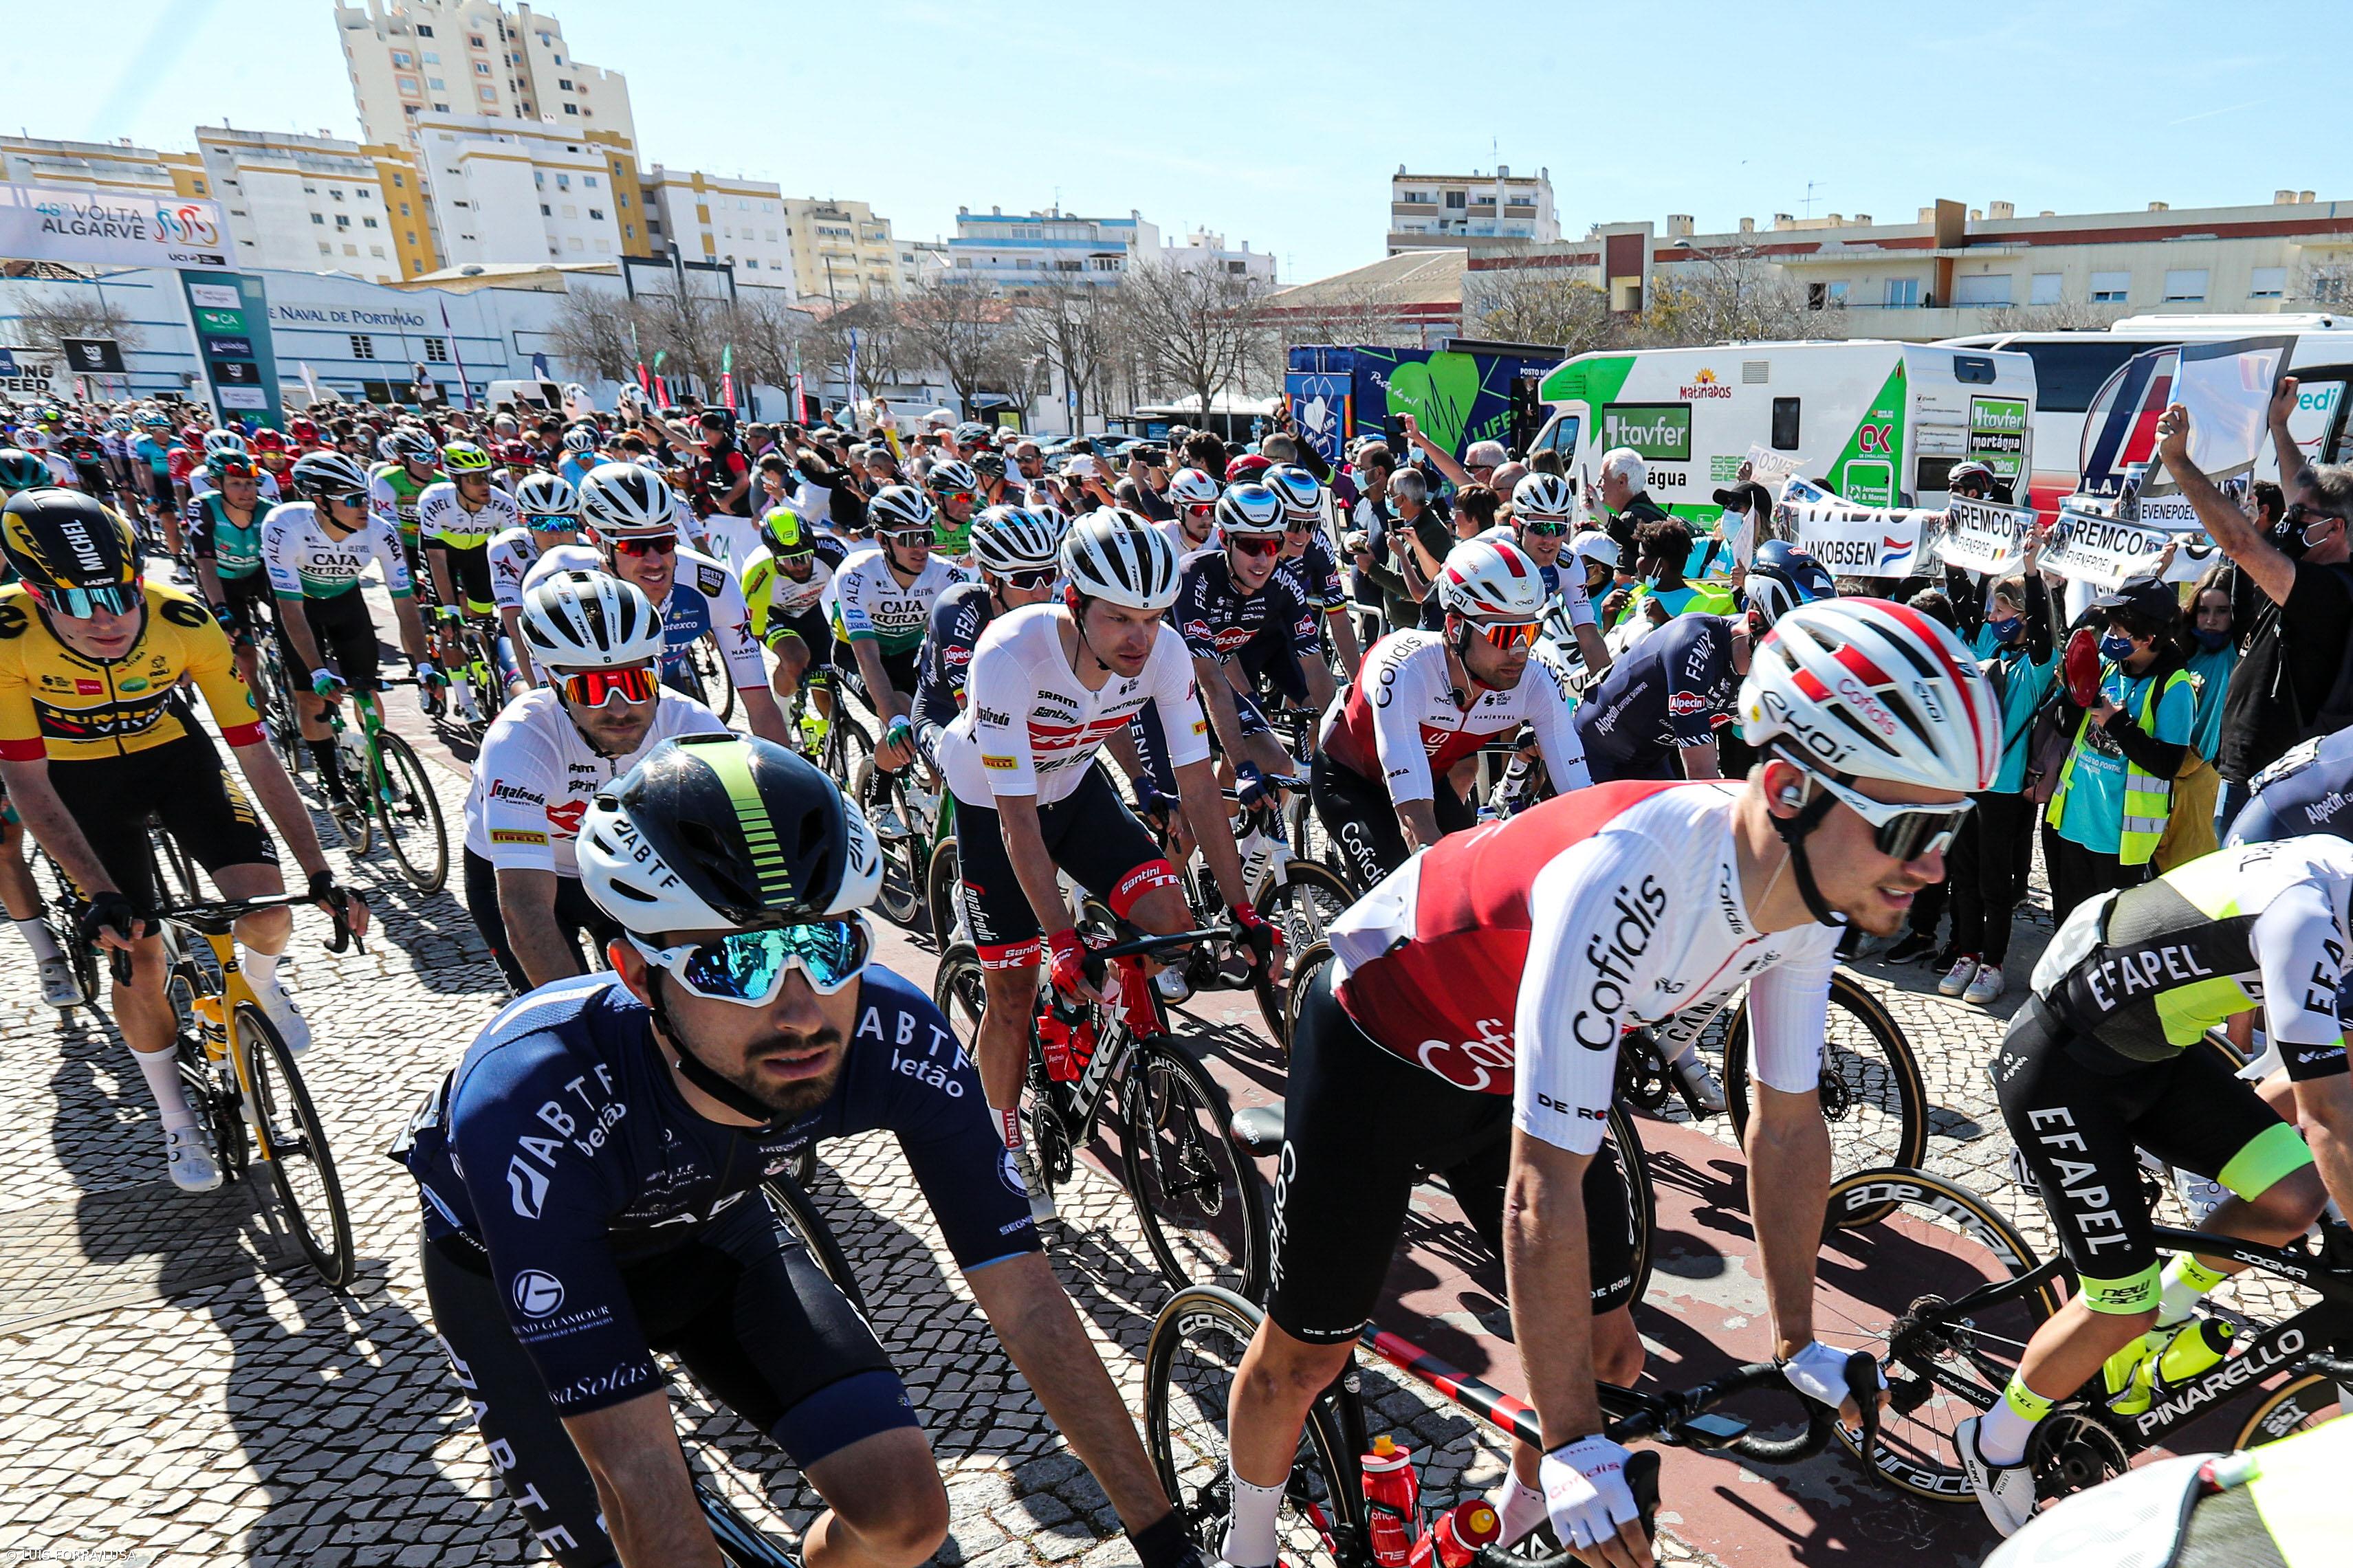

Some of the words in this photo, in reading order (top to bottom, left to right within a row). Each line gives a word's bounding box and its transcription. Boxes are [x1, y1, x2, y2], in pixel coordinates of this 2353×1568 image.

[72, 203, 144, 224] VOLTA
[41, 218, 146, 241] ALGARVE
[219, 313, 239, 325] CA
[278, 305, 327, 322] NAVAL
[329, 310, 349, 323] DE
[351, 310, 425, 327] PORTIMÃO
[1520, 367, 1540, 375] POSTO
[1982, 407, 2022, 429] tavfer
[1972, 434, 2021, 452] mortágua
[1647, 466, 1687, 490] água
[2083, 477, 2118, 495] L.A.
[422, 498, 451, 529] EFAPEL
[1960, 504, 2013, 538] REMCO
[2141, 504, 2195, 521] EVENEPOEL
[60, 519, 107, 571] MICHEL
[267, 526, 287, 566] ALEA
[382, 533, 403, 562] RGA
[1956, 536, 1992, 558] EVENEPOEL
[2072, 520, 2143, 555] REMCO
[1805, 541, 1877, 566] JAKOBSEN
[2065, 550, 2111, 573] EVENEPOEL
[846, 571, 864, 605] ALEA
[1130, 564, 1141, 593] TREK
[1194, 573, 1210, 610] FENIX
[1271, 567, 1306, 606] Alpecin
[880, 600, 926, 615] CAJA
[953, 599, 982, 641] FENIX
[573, 613, 593, 645] TREK
[1214, 632, 1251, 647] lpecin
[1685, 630, 1716, 681] FENIX
[1376, 636, 1422, 709] Cofidis
[1037, 689, 1080, 709] SRAM
[1670, 697, 1703, 709] Alpecin
[1837, 678, 1900, 736] Cofidis
[1032, 706, 1079, 725] Santini
[1595, 705, 1619, 736] Alpecin
[2303, 791, 2347, 825] Alpecin
[622, 832, 680, 890] ABTF
[1341, 821, 1388, 889] Cofidi
[1121, 866, 1161, 896] Santini
[1718, 862, 1747, 936] Cofidis
[981, 958, 1022, 970] EK
[1572, 874, 1668, 1052] Cofidis
[2086, 943, 2212, 1012] EFAPEL
[855, 1005, 970, 1070] ABTF
[1044, 1043, 1066, 1051] TREK
[1070, 994, 1130, 1118] TREK
[518, 1061, 613, 1169] ABTF
[1537, 1092, 1570, 1115] DE
[1577, 1107, 1608, 1121] RO
[1005, 1110, 1021, 1145] TREK
[2026, 1105, 2127, 1256] EFAPEL
[1269, 1139, 1297, 1292] Cofidis
[2233, 1249, 2308, 1281] DOGMA
[542, 1305, 610, 1330] GLAMOUR
[1302, 1327, 1325, 1336] DE
[1936, 1372, 1992, 1404] PINARELLO
[2135, 1329, 2306, 1437] PINARELLO
[1968, 1459, 1982, 1486] BONT
[1999, 1473, 2011, 1492] ZERO
